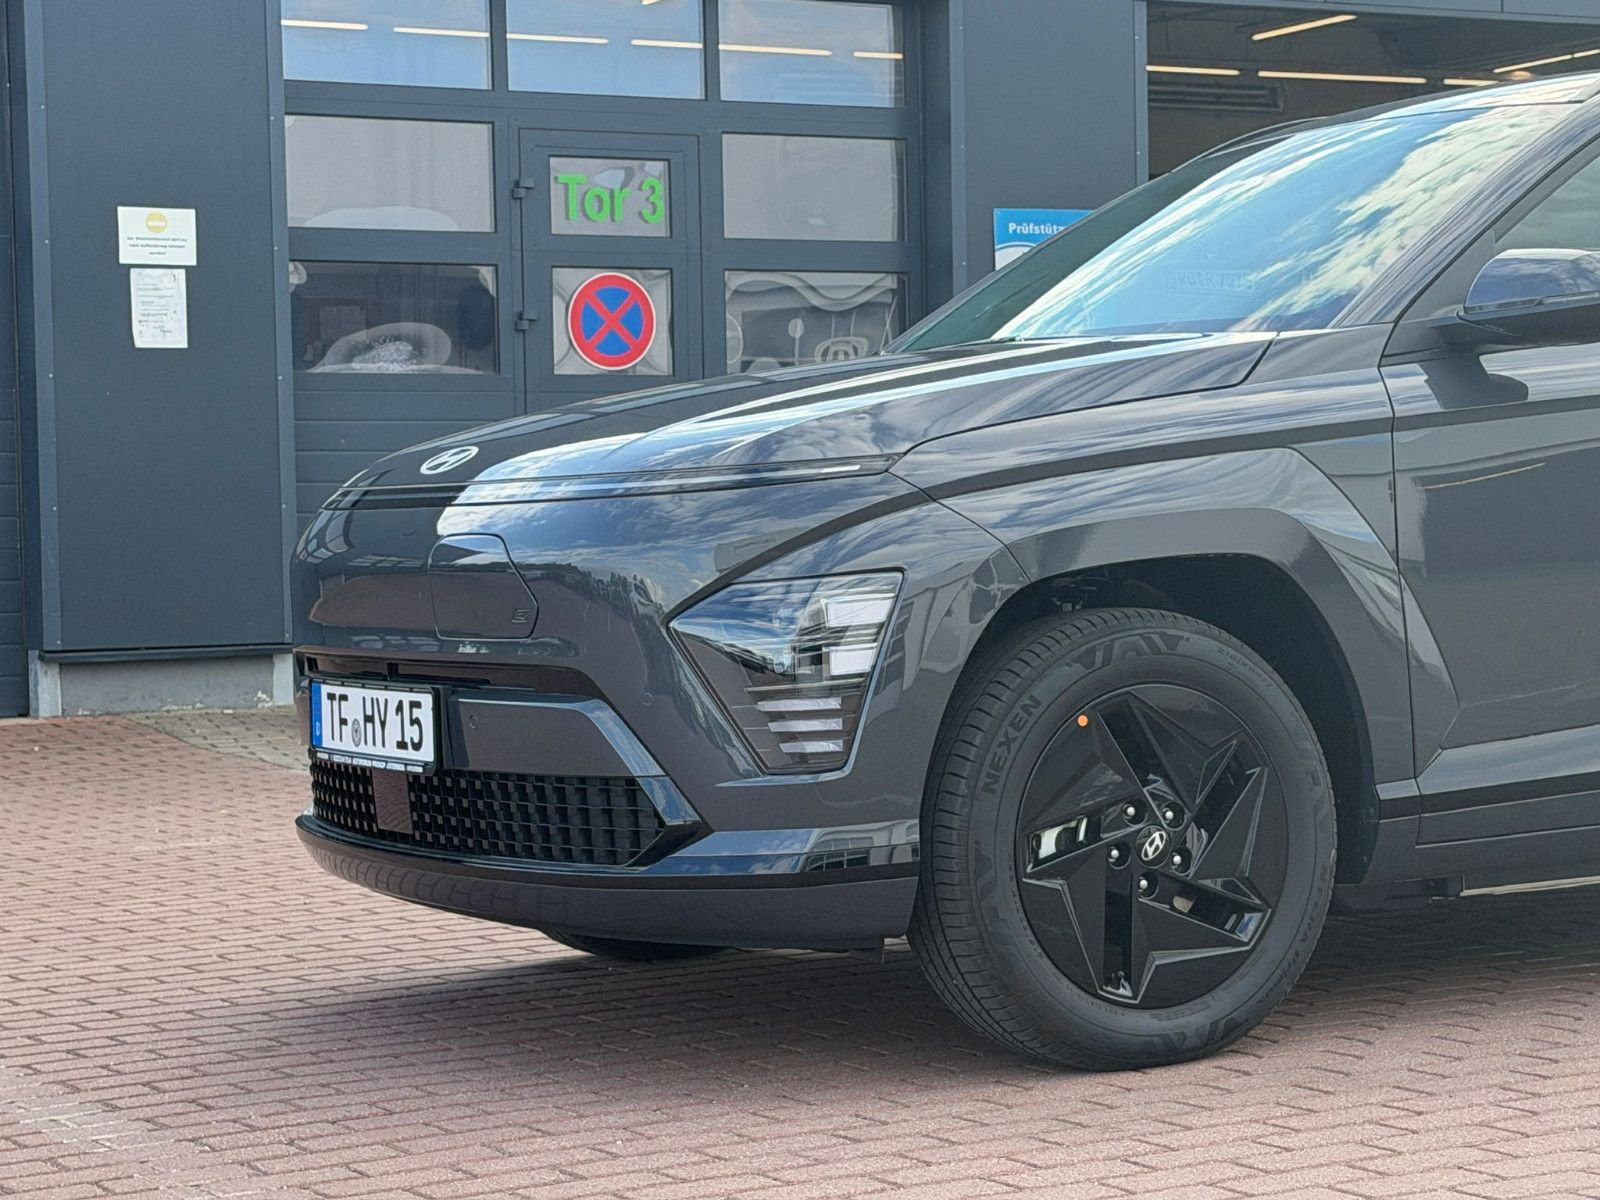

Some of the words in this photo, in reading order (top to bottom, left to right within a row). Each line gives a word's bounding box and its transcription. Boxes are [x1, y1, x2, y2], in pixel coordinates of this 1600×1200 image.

[555, 174, 632, 223] Tor
[640, 177, 665, 224] 3
[327, 691, 349, 742] TF
[362, 695, 389, 749] HY
[395, 699, 424, 752] 15
[981, 694, 1042, 795] NEXEN
